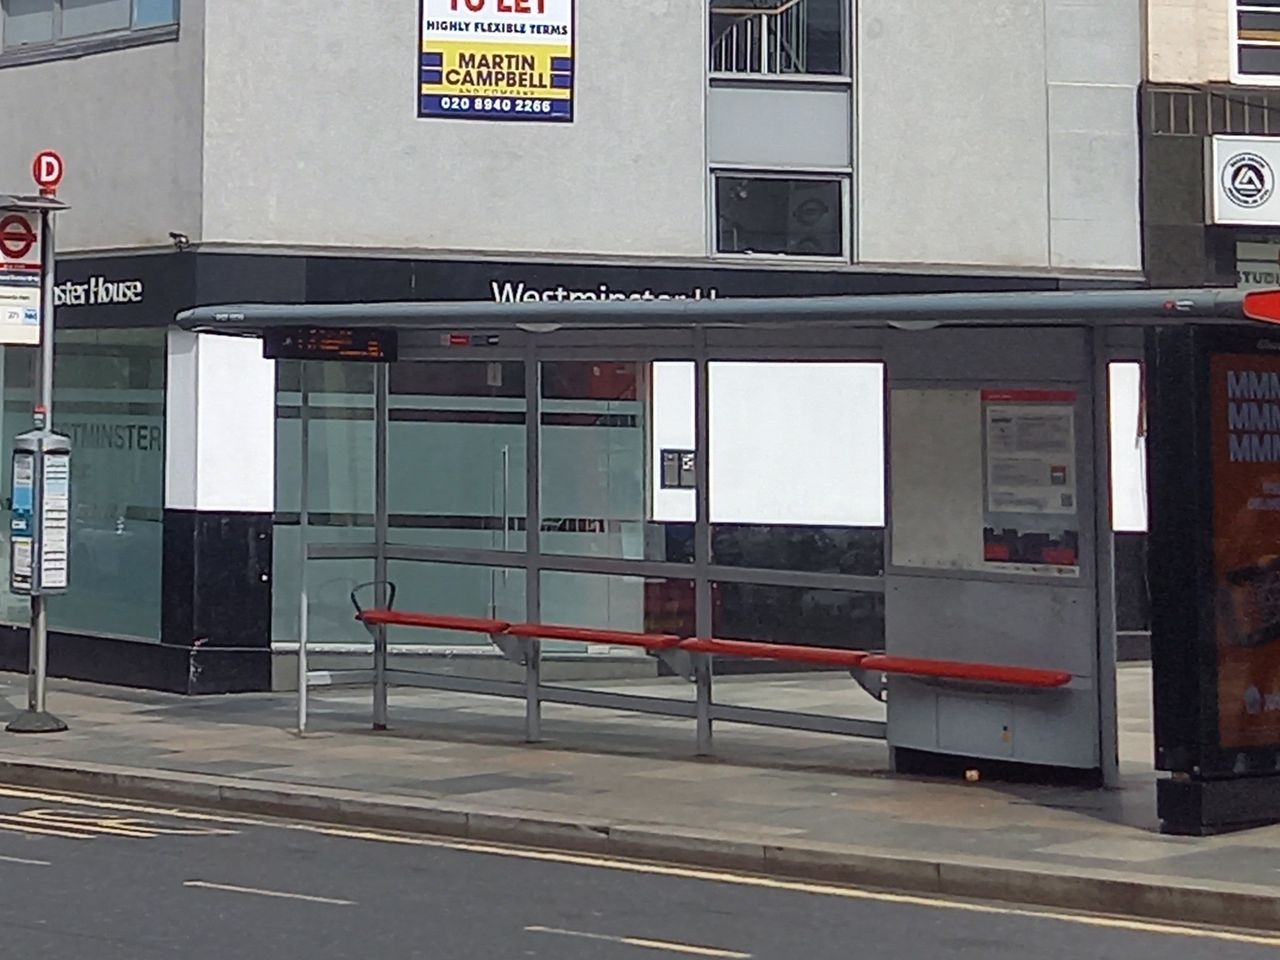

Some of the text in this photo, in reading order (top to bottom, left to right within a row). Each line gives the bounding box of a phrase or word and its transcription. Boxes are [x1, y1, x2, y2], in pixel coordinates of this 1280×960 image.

[426, 20, 568, 35] HIGHLY FLEXIBLE TERMS
[458, 52, 535, 71] MARTIN
[445, 69, 547, 89] CAMPBELL
[441, 98, 470, 110] 020
[474, 98, 511, 111] 8940
[40, 155, 60, 182] D
[89, 277, 143, 305] House
